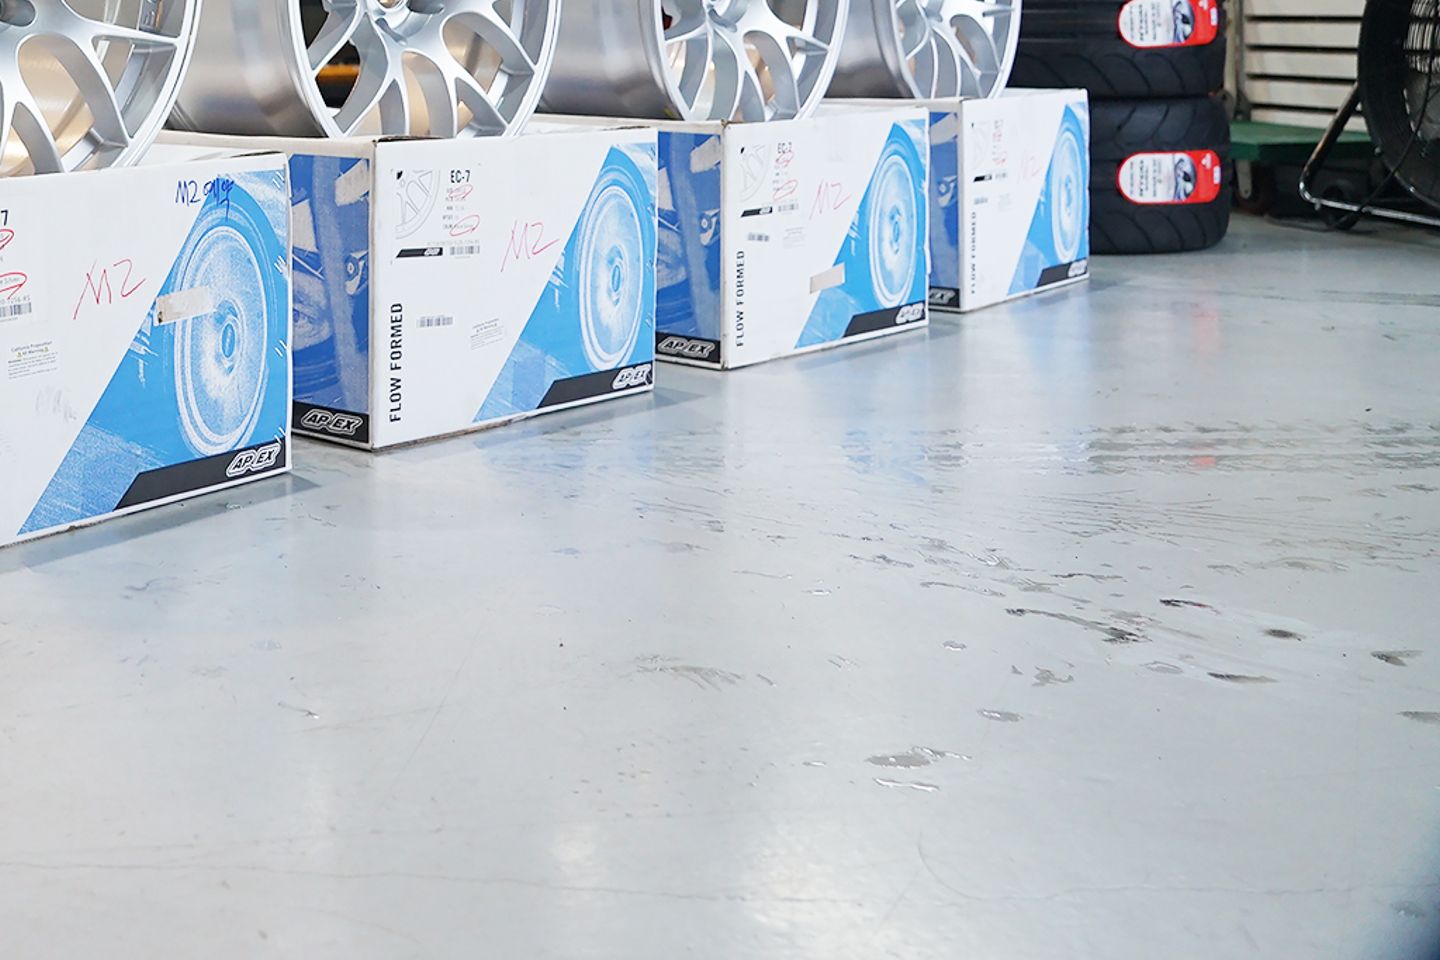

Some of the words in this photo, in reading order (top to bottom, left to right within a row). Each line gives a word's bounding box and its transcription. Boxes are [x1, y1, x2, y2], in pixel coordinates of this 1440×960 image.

[175, 180, 201, 207] M2
[450, 169, 471, 183] EC-7
[809, 180, 852, 221] M2
[500, 220, 560, 272] M2
[73, 258, 146, 320] M2
[735, 250, 745, 306] FORMED
[390, 303, 403, 371] FORMED
[735, 310, 745, 347] FLOW
[389, 377, 402, 422] FLOW
[303, 411, 360, 434] APEX
[229, 446, 279, 473] APEX
